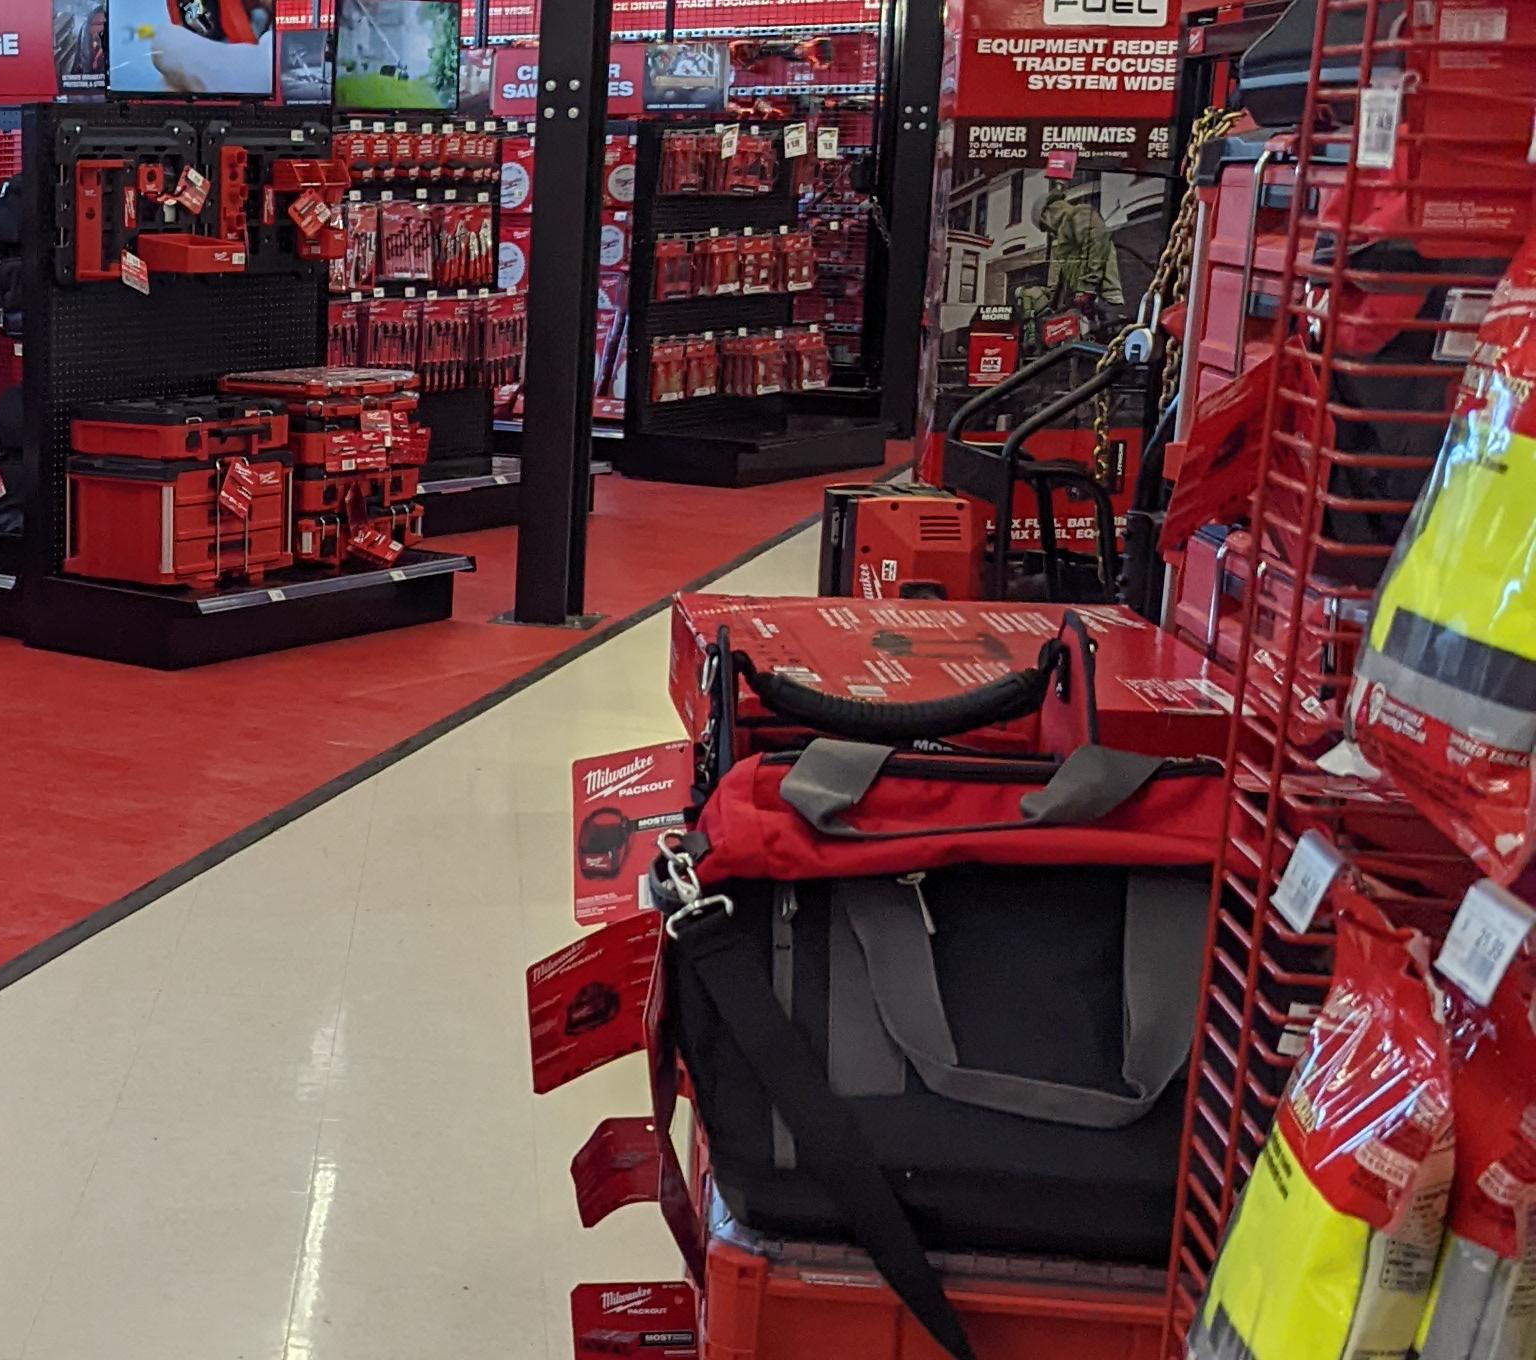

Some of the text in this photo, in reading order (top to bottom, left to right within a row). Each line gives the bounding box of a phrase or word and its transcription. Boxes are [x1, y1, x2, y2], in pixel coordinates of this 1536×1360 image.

[977, 38, 1178, 55] EQUIPMENT REDEF
[1013, 57, 1177, 73] TRADE FOCUSE
[1027, 75, 1175, 91] SYSTEM WIDE
[969, 126, 1027, 142] POWER
[1042, 126, 1136, 143] ELIMINATES
[995, 149, 1027, 158] HEAD
[582, 753, 655, 795] Milwaukee
[619, 779, 675, 797] PACKOUT
